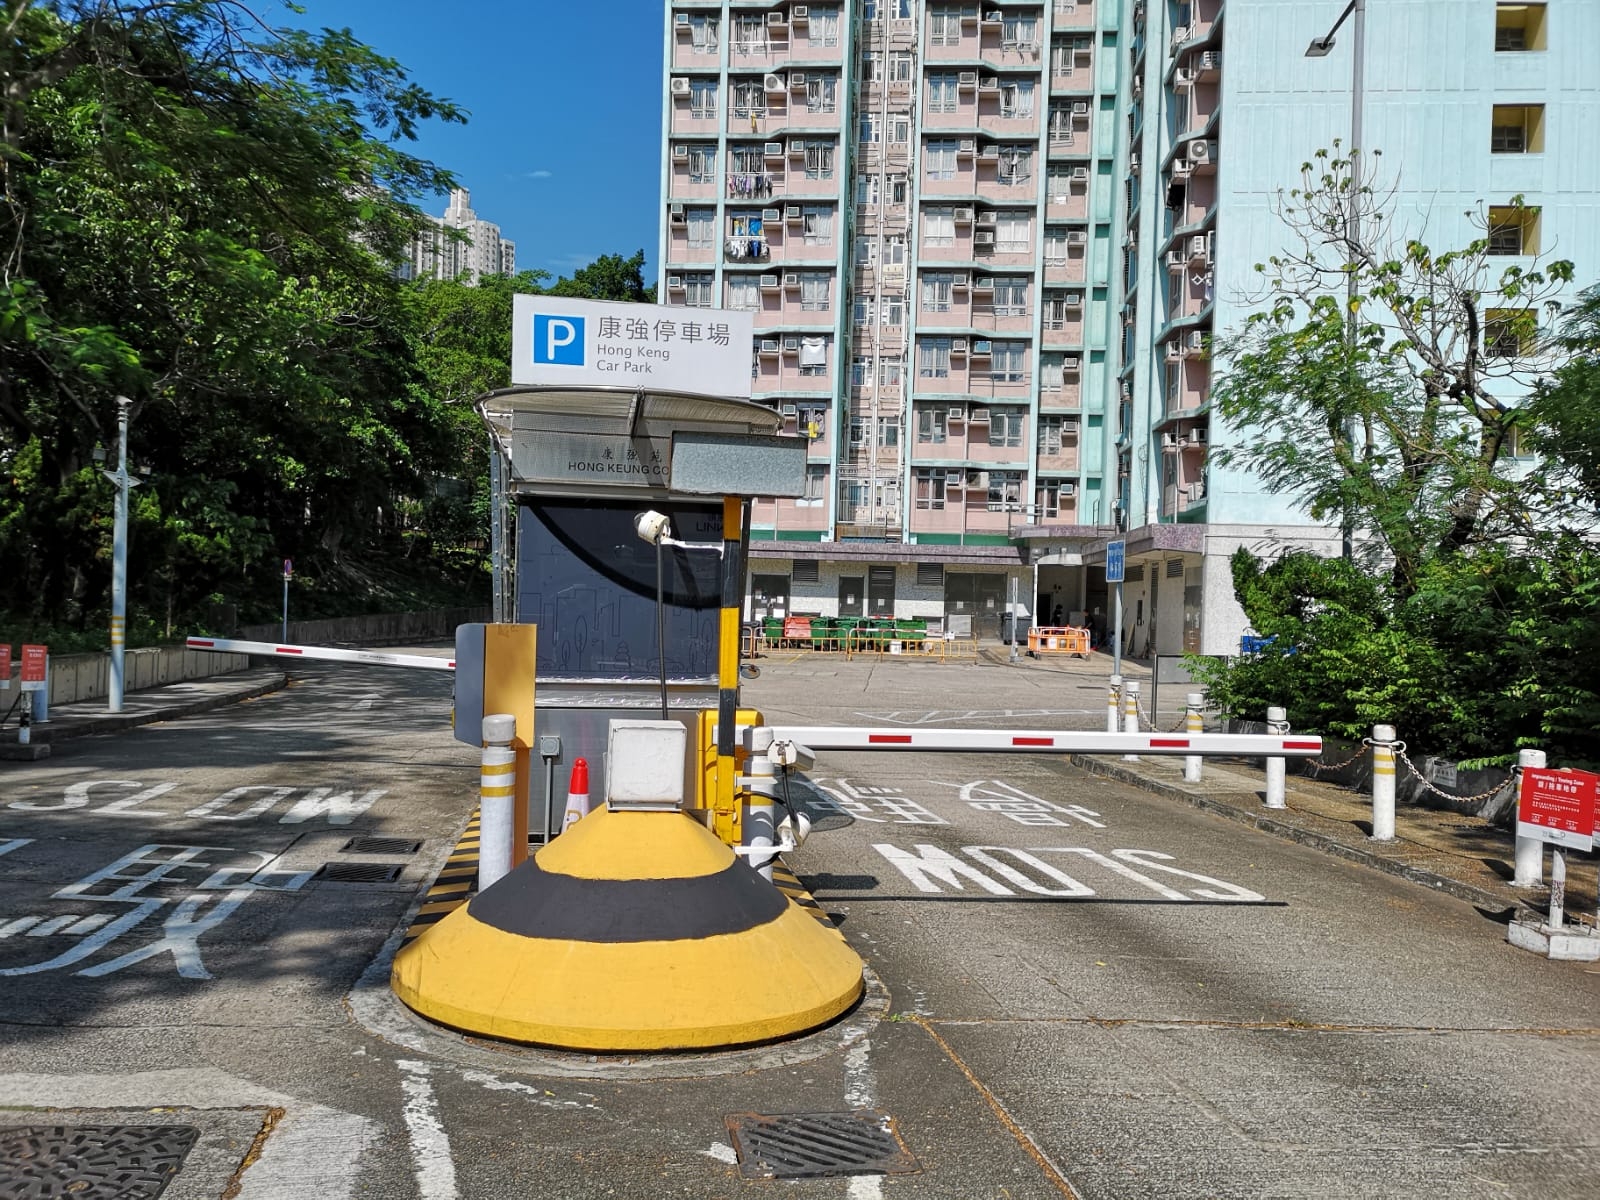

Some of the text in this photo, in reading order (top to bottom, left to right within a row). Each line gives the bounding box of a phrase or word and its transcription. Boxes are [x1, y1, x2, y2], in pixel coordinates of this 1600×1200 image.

[547, 319, 576, 361] P
[598, 316, 730, 346] 康強停車場
[597, 344, 670, 361] Hong Keng
[597, 360, 653, 374] Car Park
[568, 462, 604, 472] HONG
[607, 463, 649, 474] KEUNG
[7, 779, 390, 825] SLOW
[871, 843, 1266, 902] SLOW
[0, 838, 319, 979] 駛
